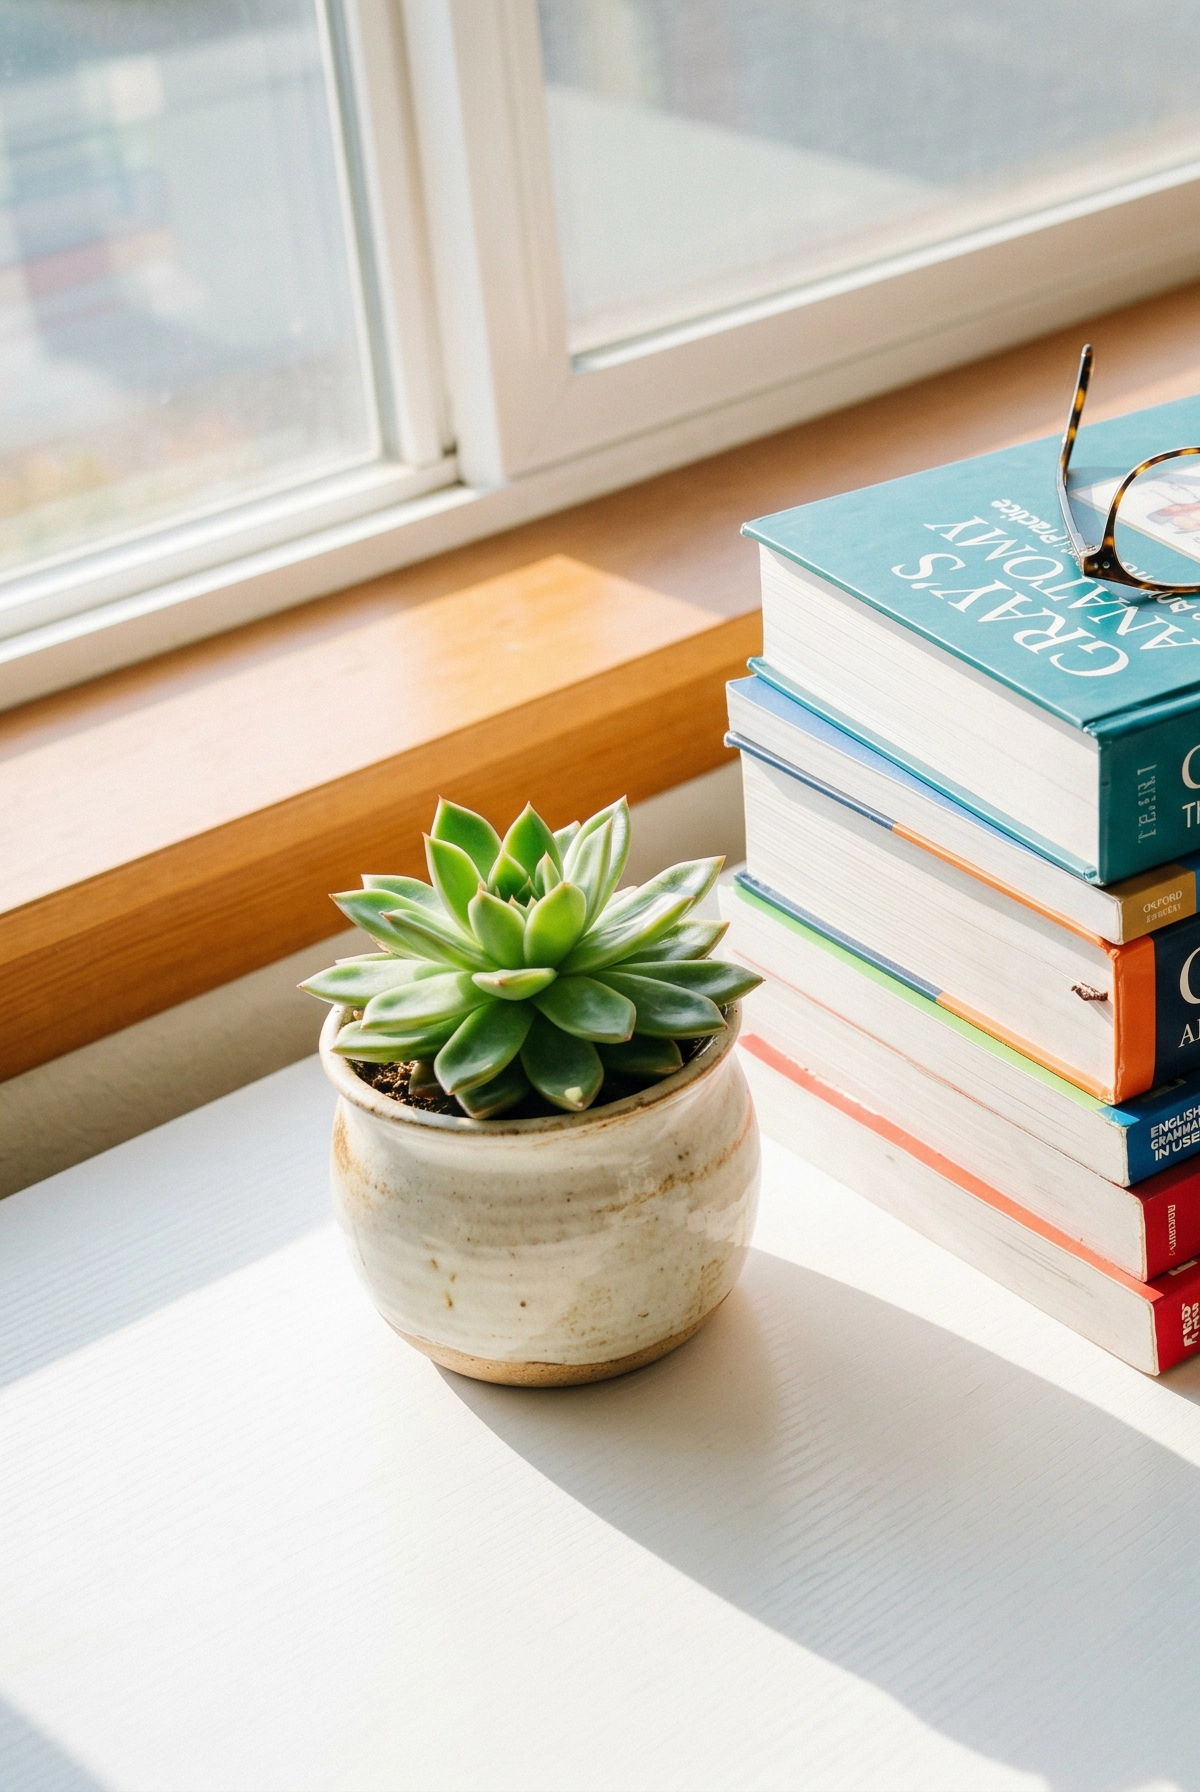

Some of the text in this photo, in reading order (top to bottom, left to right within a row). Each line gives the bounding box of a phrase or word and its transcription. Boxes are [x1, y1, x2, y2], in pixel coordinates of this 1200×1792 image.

[891, 553, 1129, 677] GRAY'S
[1150, 1104, 1200, 1139] ENGLISH
[1155, 1130, 1200, 1161] IN USE
